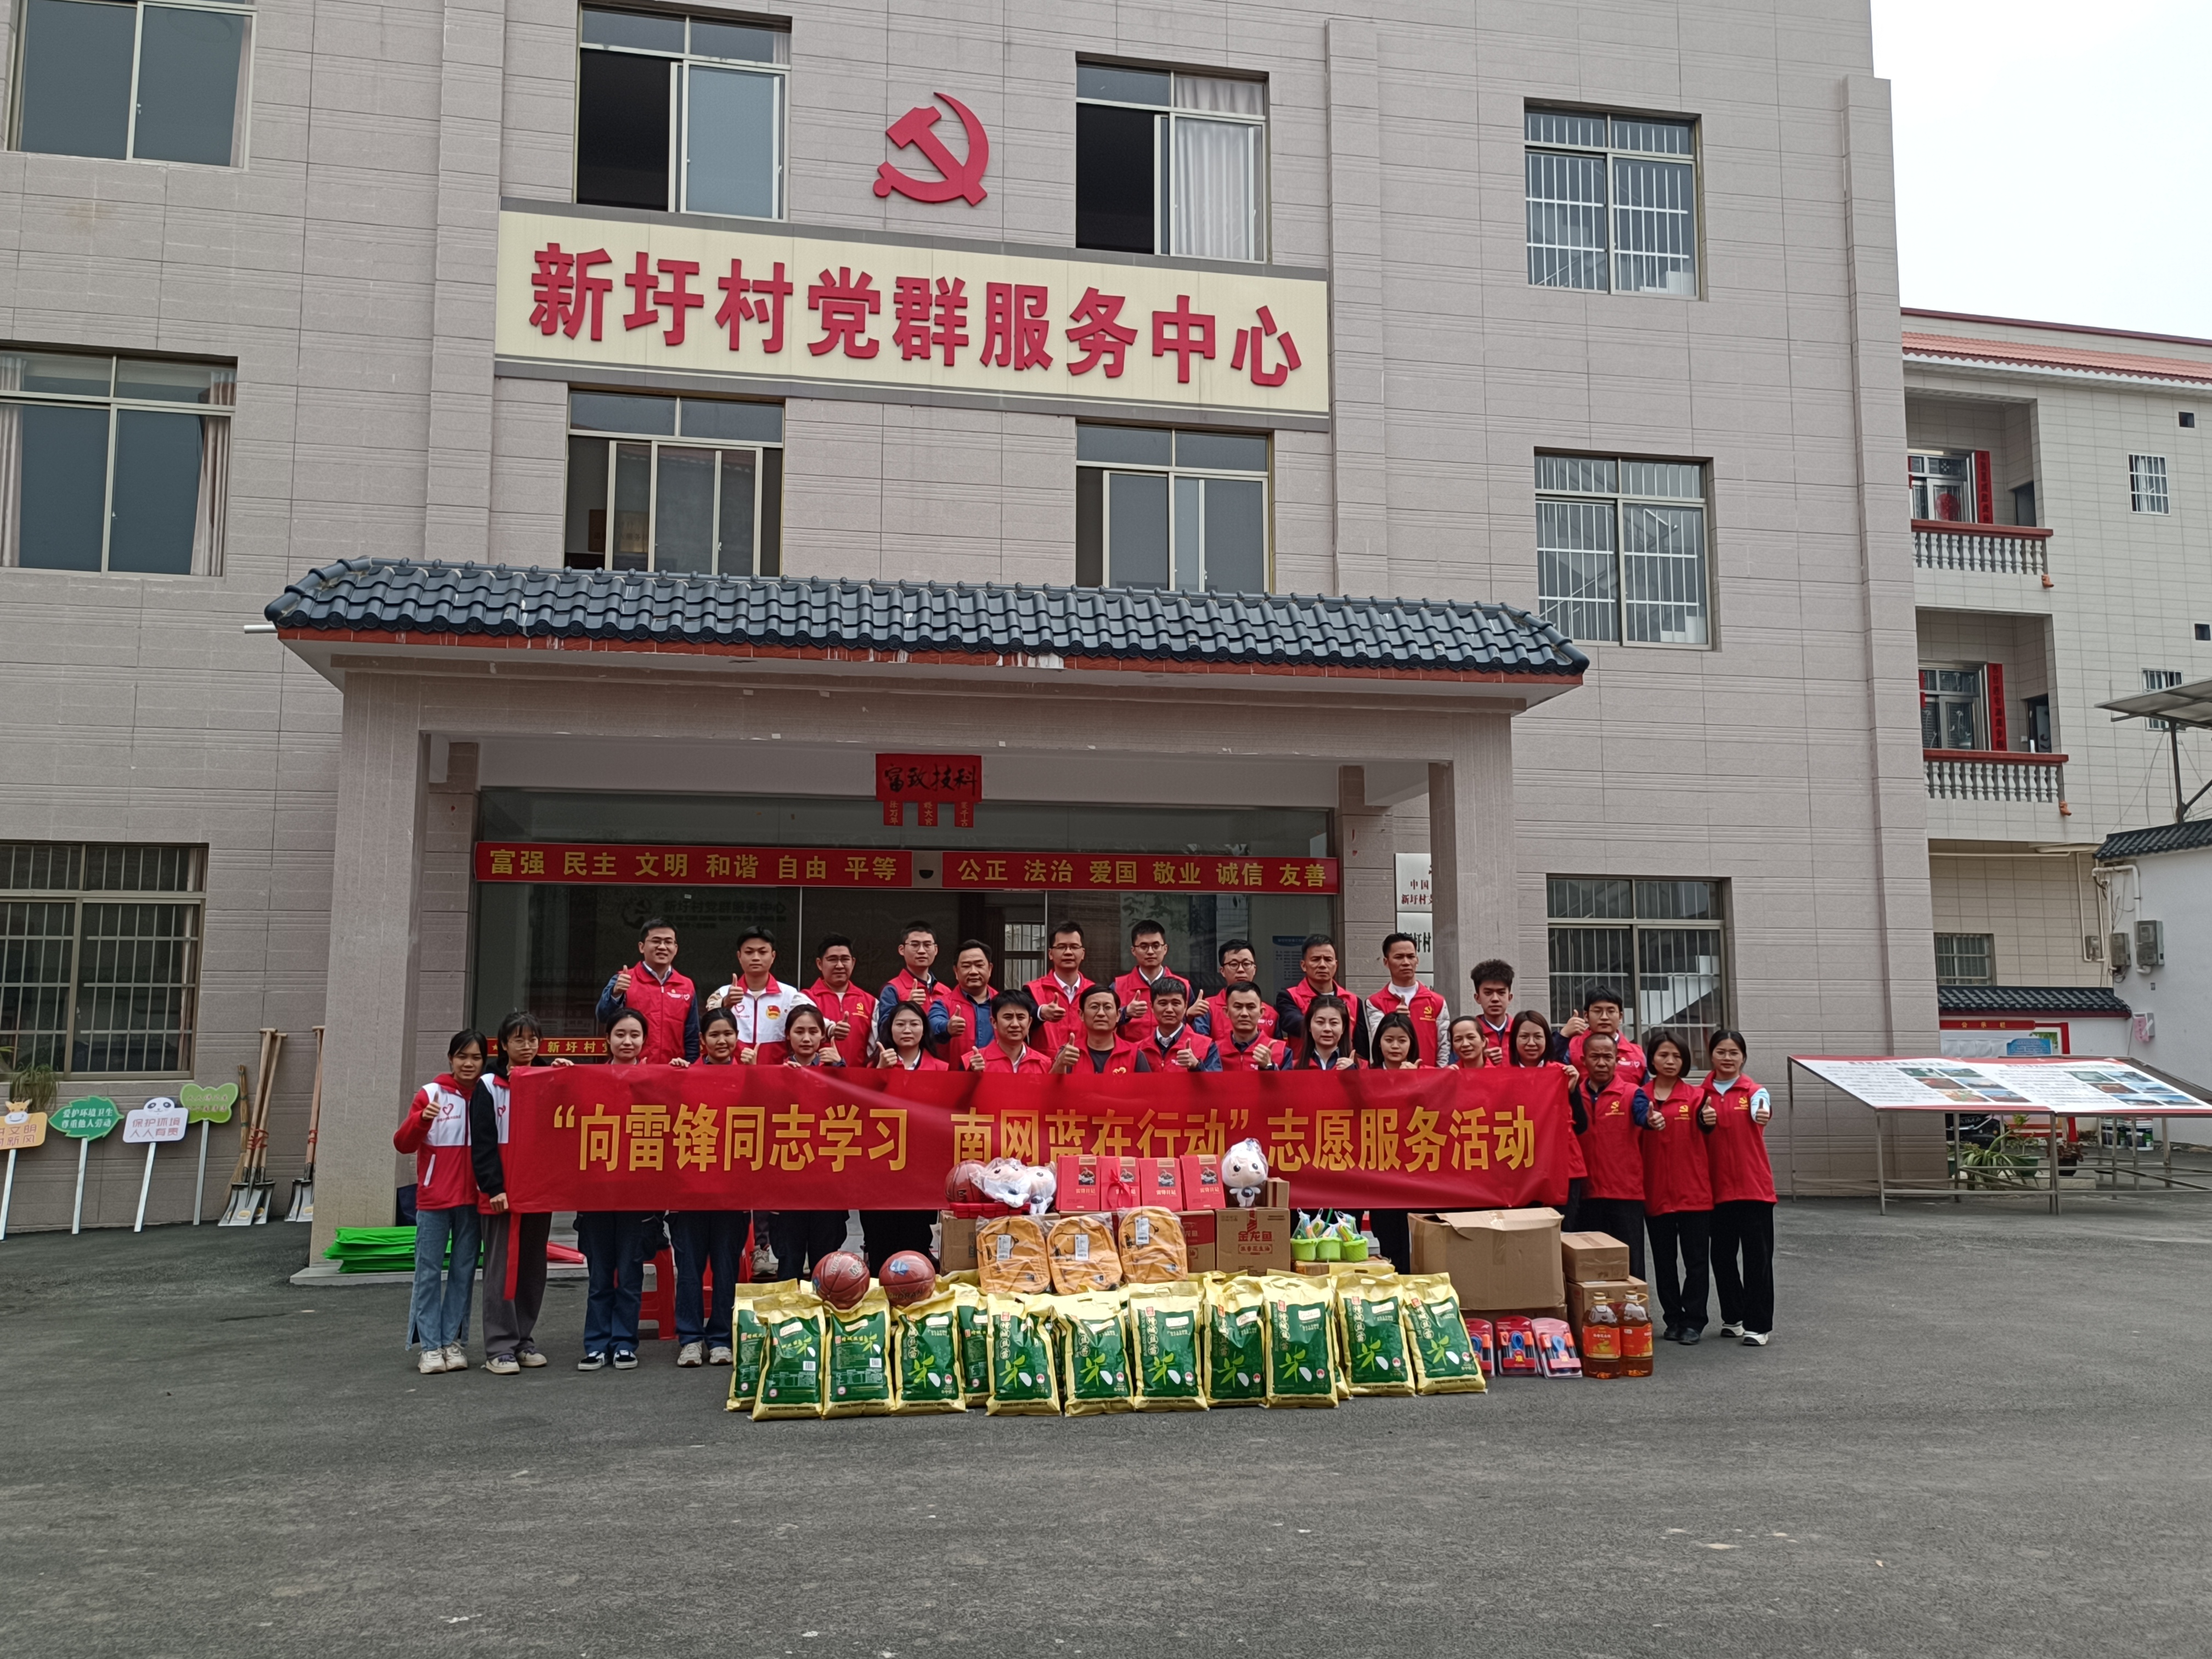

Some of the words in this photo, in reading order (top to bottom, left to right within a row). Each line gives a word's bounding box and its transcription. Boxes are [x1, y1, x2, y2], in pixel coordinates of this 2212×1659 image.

[530, 243, 1301, 386] 新圩村党群服务中心
[489, 849, 544, 874] 富强
[563, 852, 617, 876] 民主
[635, 853, 688, 877] 文明
[707, 855, 759, 878] 和谐
[778, 856, 827, 879] 自由
[845, 857, 897, 881] 平等
[958, 859, 1008, 881] 公正
[1024, 860, 1074, 883] 法治
[1089, 860, 1138, 884] 爱国
[1153, 861, 1201, 885] 敬业
[1216, 862, 1263, 885] 诚信
[1279, 864, 1326, 888] 友善
[63, 1108, 113, 1119] 爱护环境卫生
[61, 1119, 111, 1129] 尊重他人劳动
[132, 1117, 180, 1128] 保护环境
[129, 1127, 179, 1139] 人人有责
[554, 1104, 908, 1172] “向雷锋同志学习
[1238, 1231, 1272, 1242] 金龙鱼
